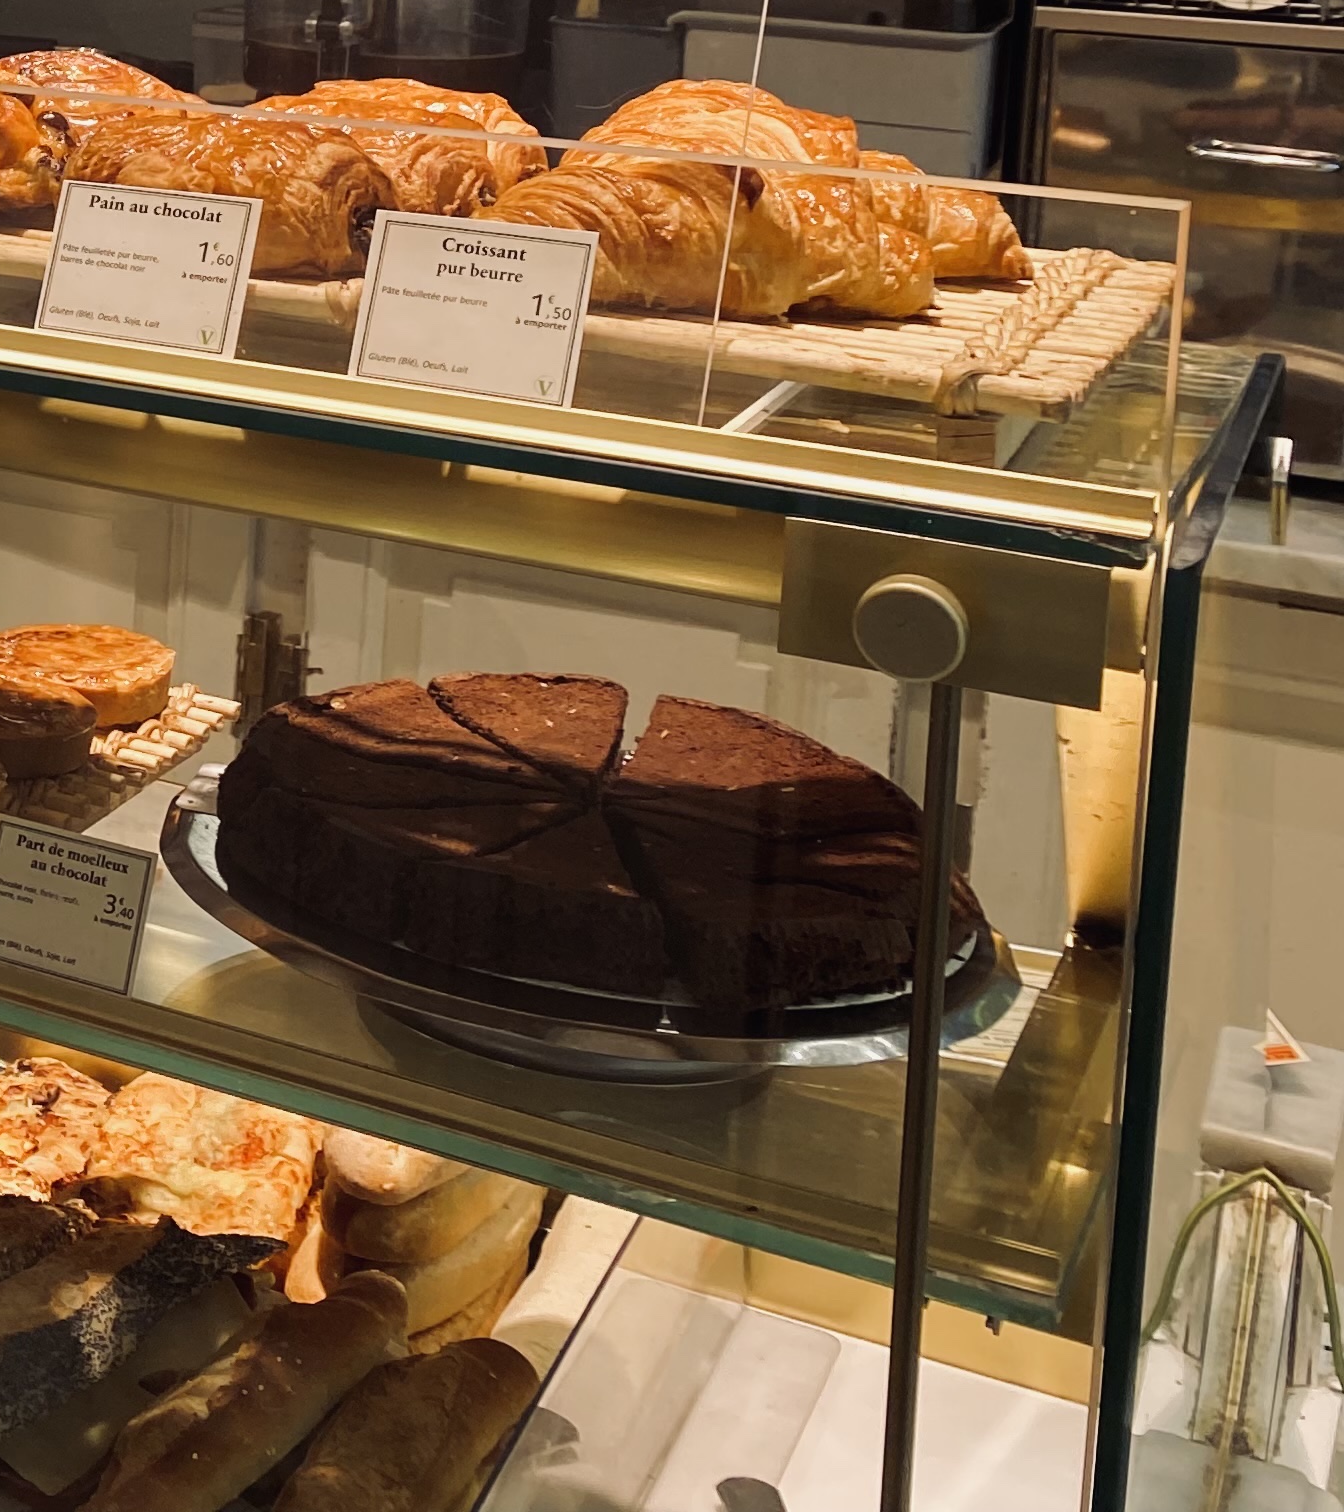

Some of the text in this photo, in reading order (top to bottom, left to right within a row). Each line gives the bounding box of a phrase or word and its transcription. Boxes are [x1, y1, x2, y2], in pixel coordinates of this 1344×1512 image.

[89, 194, 223, 223] Pain au chocolat
[442, 237, 528, 262] Croissant
[189, 273, 227, 284] emporter
[436, 262, 524, 283] pur beurre
[523, 319, 568, 331] emporter
[16, 834, 129, 874] Part de moelleux
[30, 859, 108, 887] au chocolat
